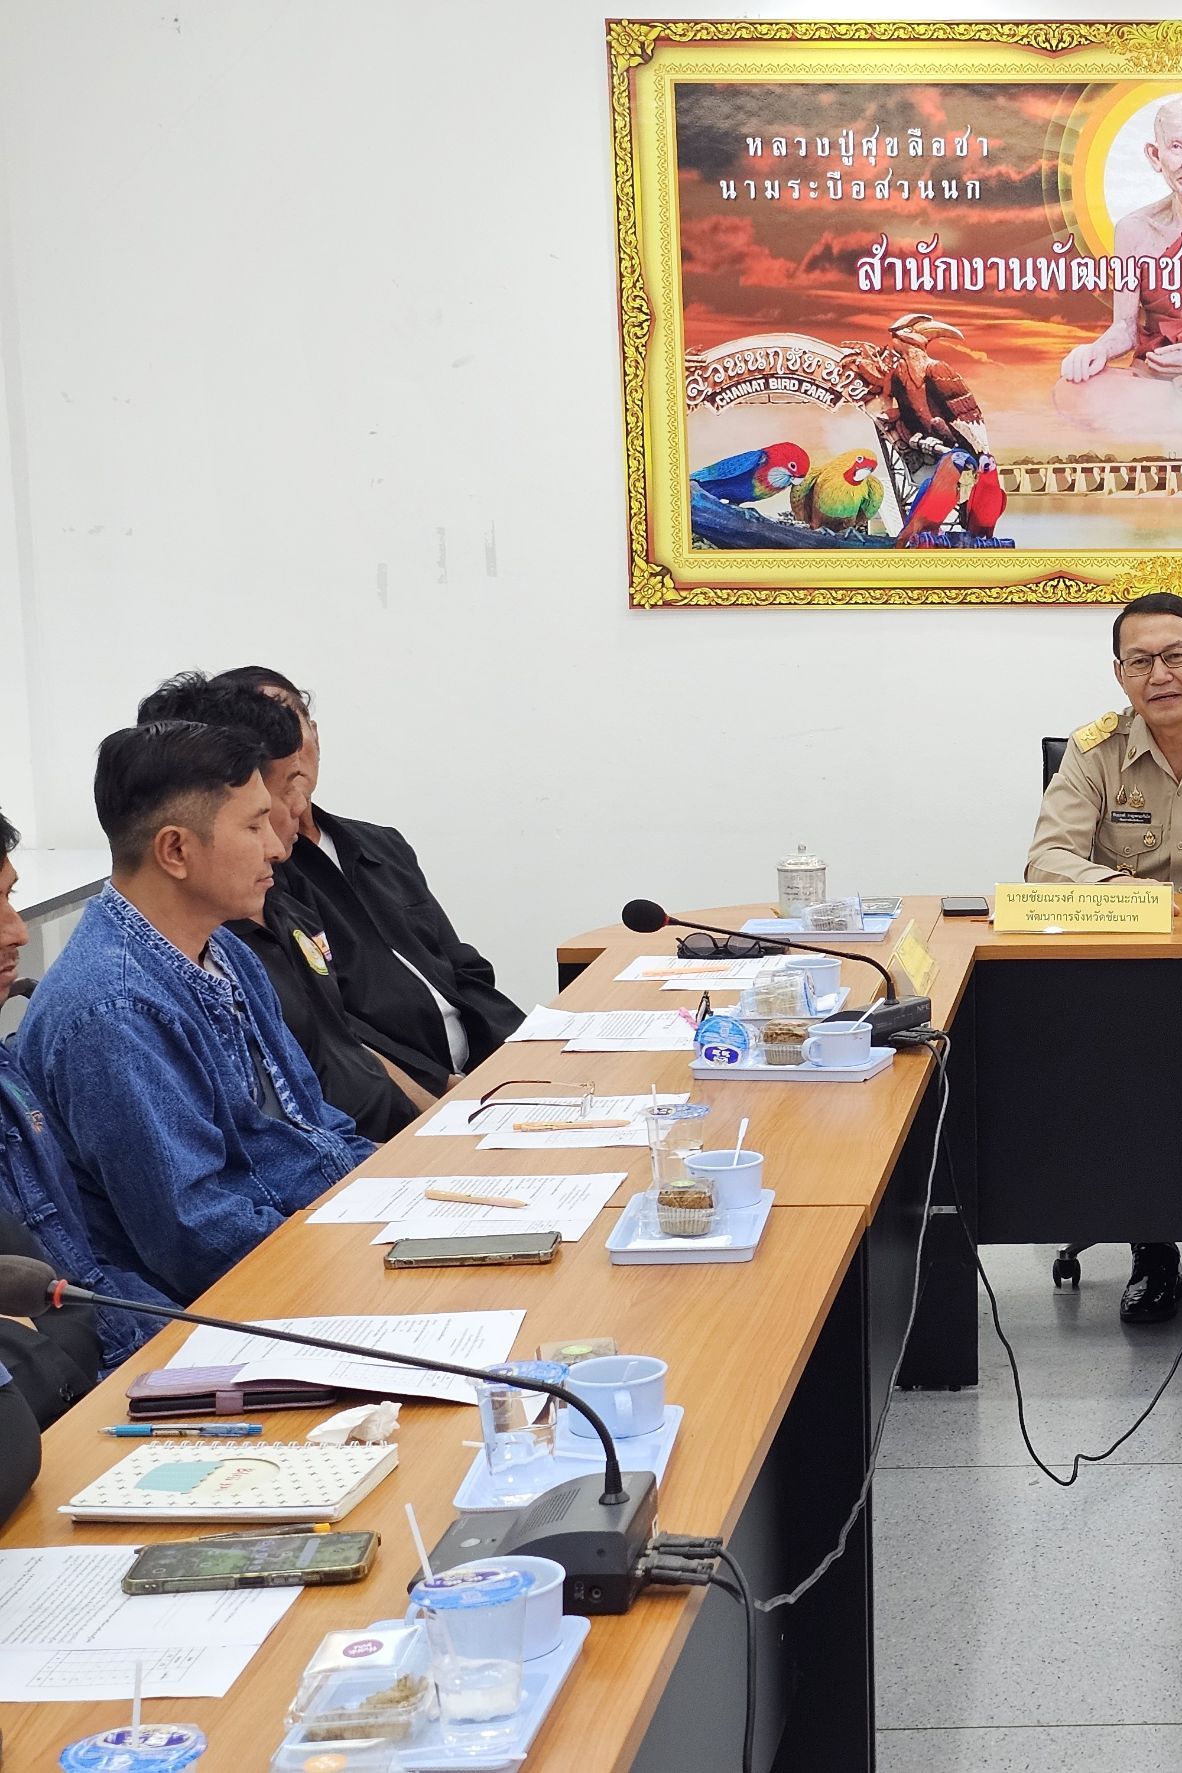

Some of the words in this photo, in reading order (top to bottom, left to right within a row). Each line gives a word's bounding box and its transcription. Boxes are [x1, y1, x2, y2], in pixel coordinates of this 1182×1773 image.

[719, 168, 982, 201] นามระบือสวนนก
[715, 378, 766, 406] CHAINAT
[769, 377, 799, 392] BIRD
[801, 381, 836, 405] PARK
[1026, 909, 1140, 923] พัฒนาการจังหวัดชัยนาท
